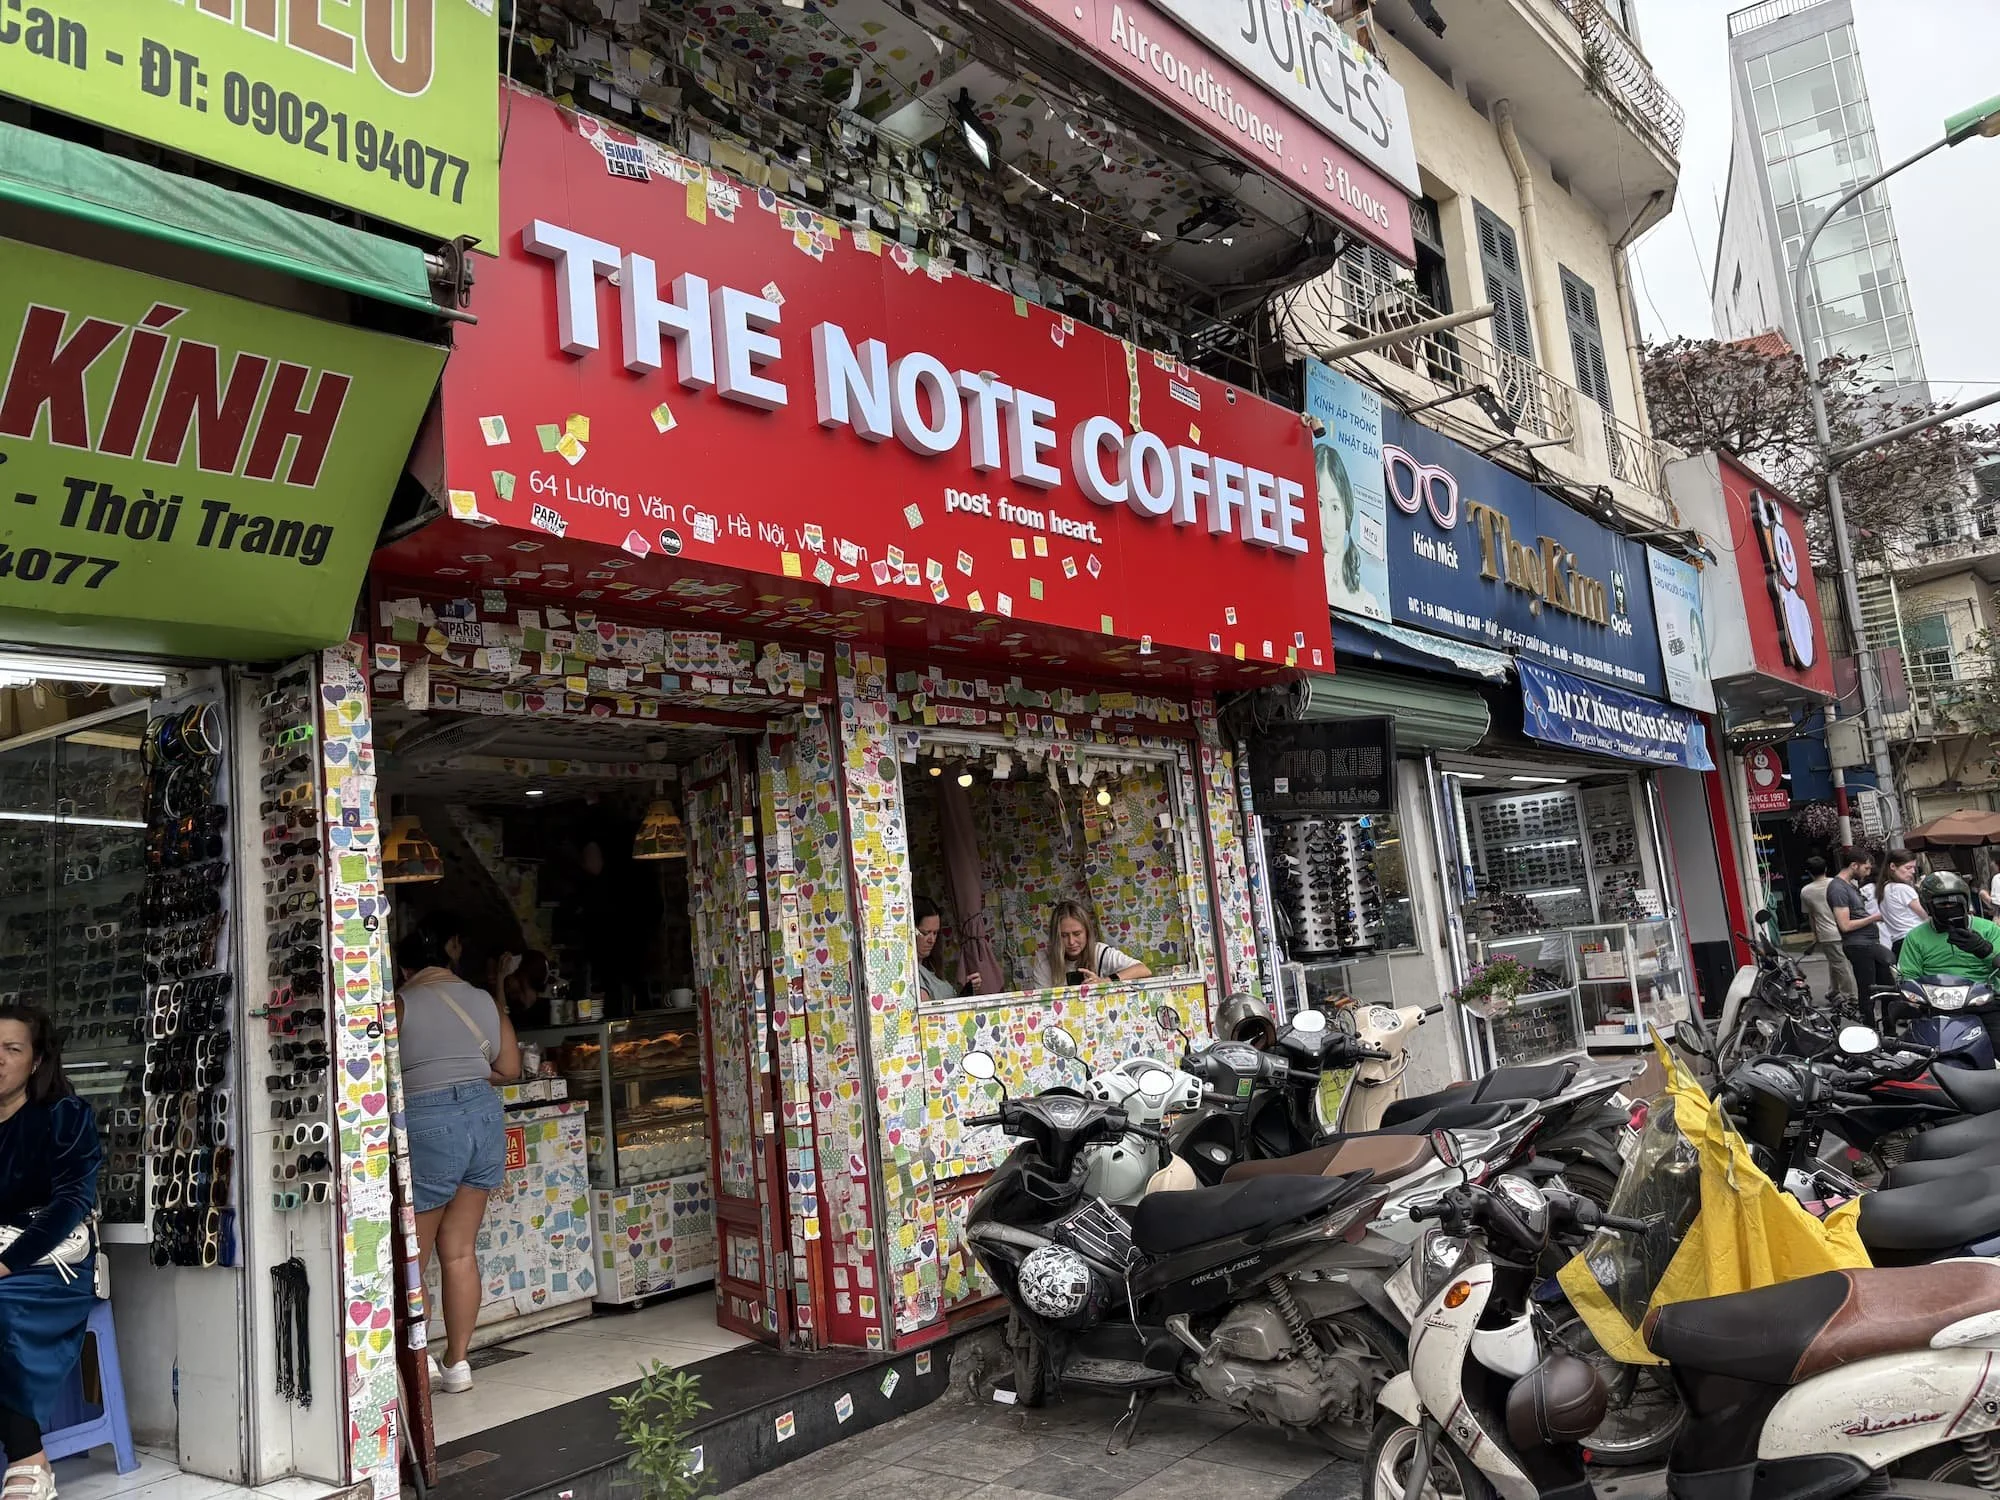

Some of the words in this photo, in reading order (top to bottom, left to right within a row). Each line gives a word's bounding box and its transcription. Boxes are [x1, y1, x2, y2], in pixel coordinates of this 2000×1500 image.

[1240, 0, 1390, 149] JUICES
[140, 37, 208, 113] ĐT:
[224, 71, 469, 204] 0902194077
[1110, 3, 1284, 159] Airconditioner
[1336, 167, 1390, 229] floors
[0, 300, 353, 488] KÍNH
[523, 218, 788, 411] THE
[812, 321, 1061, 490] NOTE
[1071, 414, 1309, 555] COFFEE
[1314, 394, 1334, 416] KÍNH
[1335, 407, 1348, 419] ÁP
[1349, 412, 1377, 436] TRÒNG
[1339, 431, 1361, 452] NHẬT
[1362, 442, 1379, 460] BẢN
[60, 476, 184, 542] Thời
[196, 499, 334, 566] Trang
[529, 470, 558, 497] 64
[565, 478, 630, 517] Lương
[638, 494, 675, 522] Văn
[727, 513, 751, 538] Hà
[758, 521, 790, 551] Nội,
[833, 537, 868, 562] Nm
[944, 488, 992, 517] post
[997, 497, 1045, 531] from
[1049, 510, 1102, 544] heart.
[1413, 531, 1436, 560] Kính
[1437, 541, 1459, 570] Mắt
[450, 623, 480, 637] PARIS
[1466, 615, 1480, 631] CAN
[1611, 613, 1633, 637] Optic
[1546, 685, 1572, 721] ĐẠI
[1572, 689, 1591, 723] LÝ
[1592, 695, 1622, 732] KÍNH
[1622, 705, 1656, 739] CHÍNH
[1331, 746, 1382, 777] KIM
[1748, 794, 1768, 802] SINCE
[1770, 792, 1784, 802] 1997
